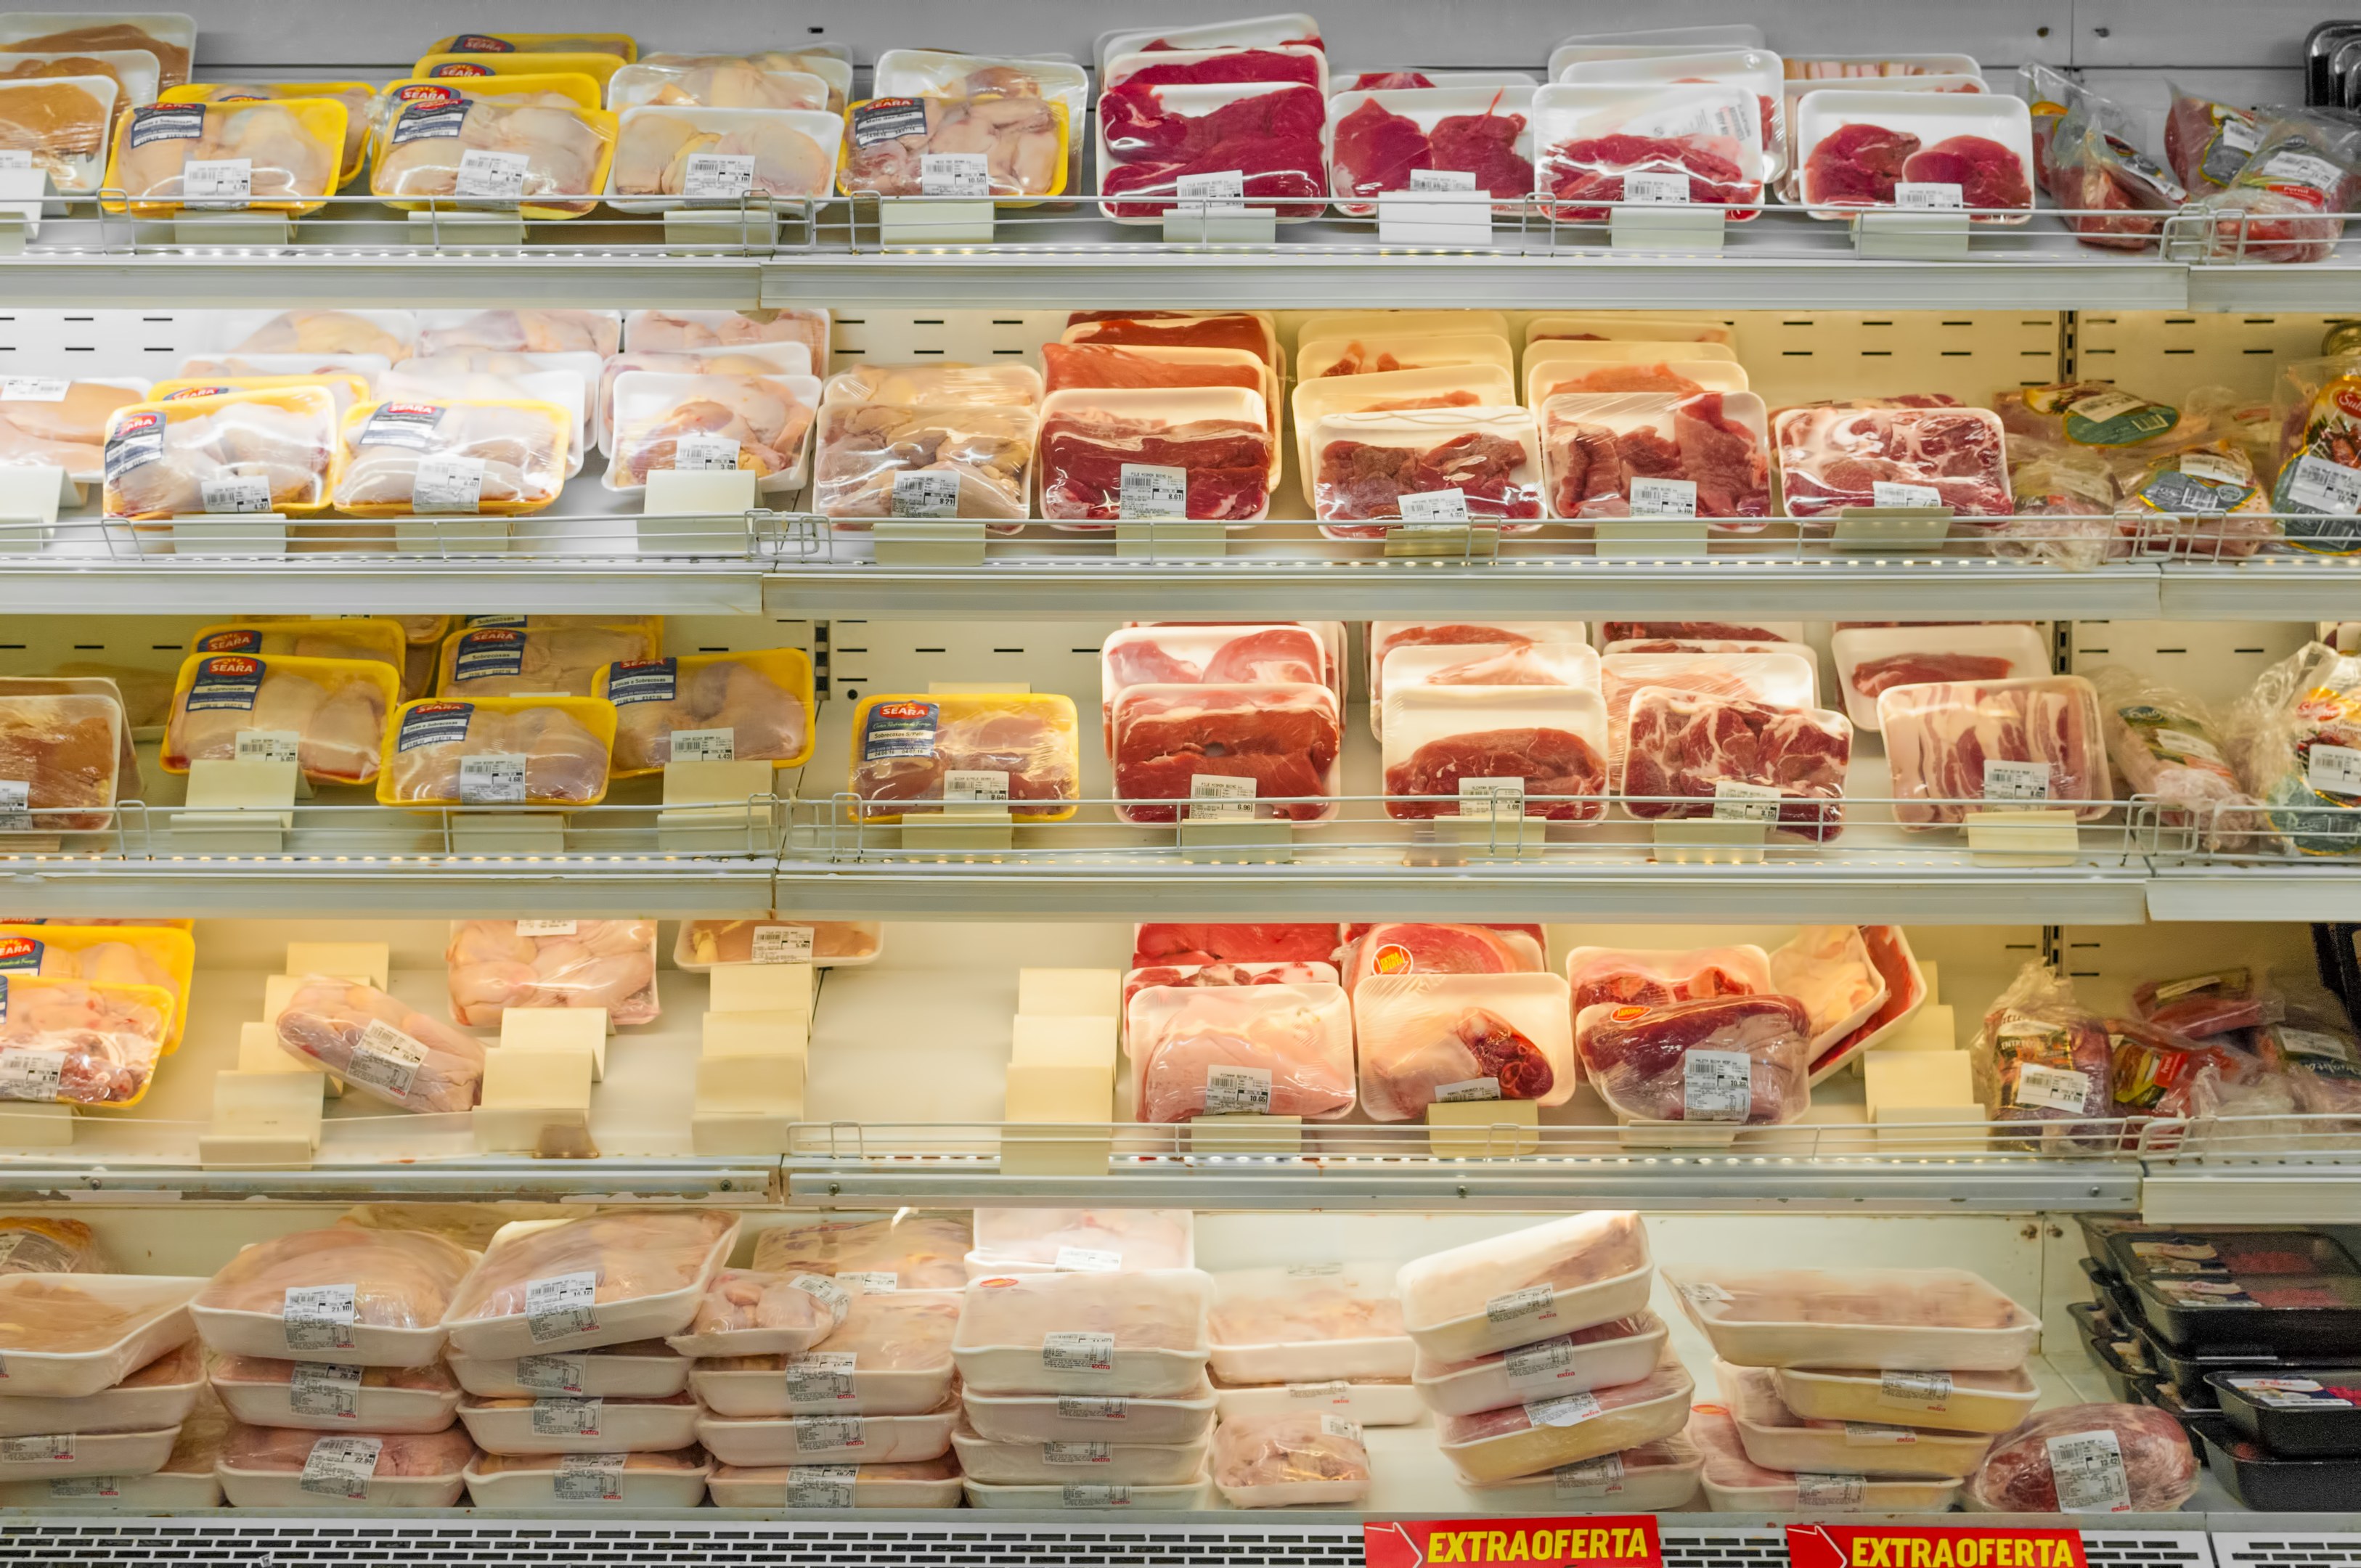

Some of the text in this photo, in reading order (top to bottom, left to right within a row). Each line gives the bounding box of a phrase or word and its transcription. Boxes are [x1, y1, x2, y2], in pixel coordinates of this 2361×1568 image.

[438, 68, 481, 77] SEARA
[402, 90, 446, 101] SEARA
[389, 404, 433, 414] SEARA
[209, 634, 250, 649] SEARA
[474, 632, 514, 641] SEARA
[882, 707, 925, 716] SEARA
[0, 944, 31, 955] EARA
